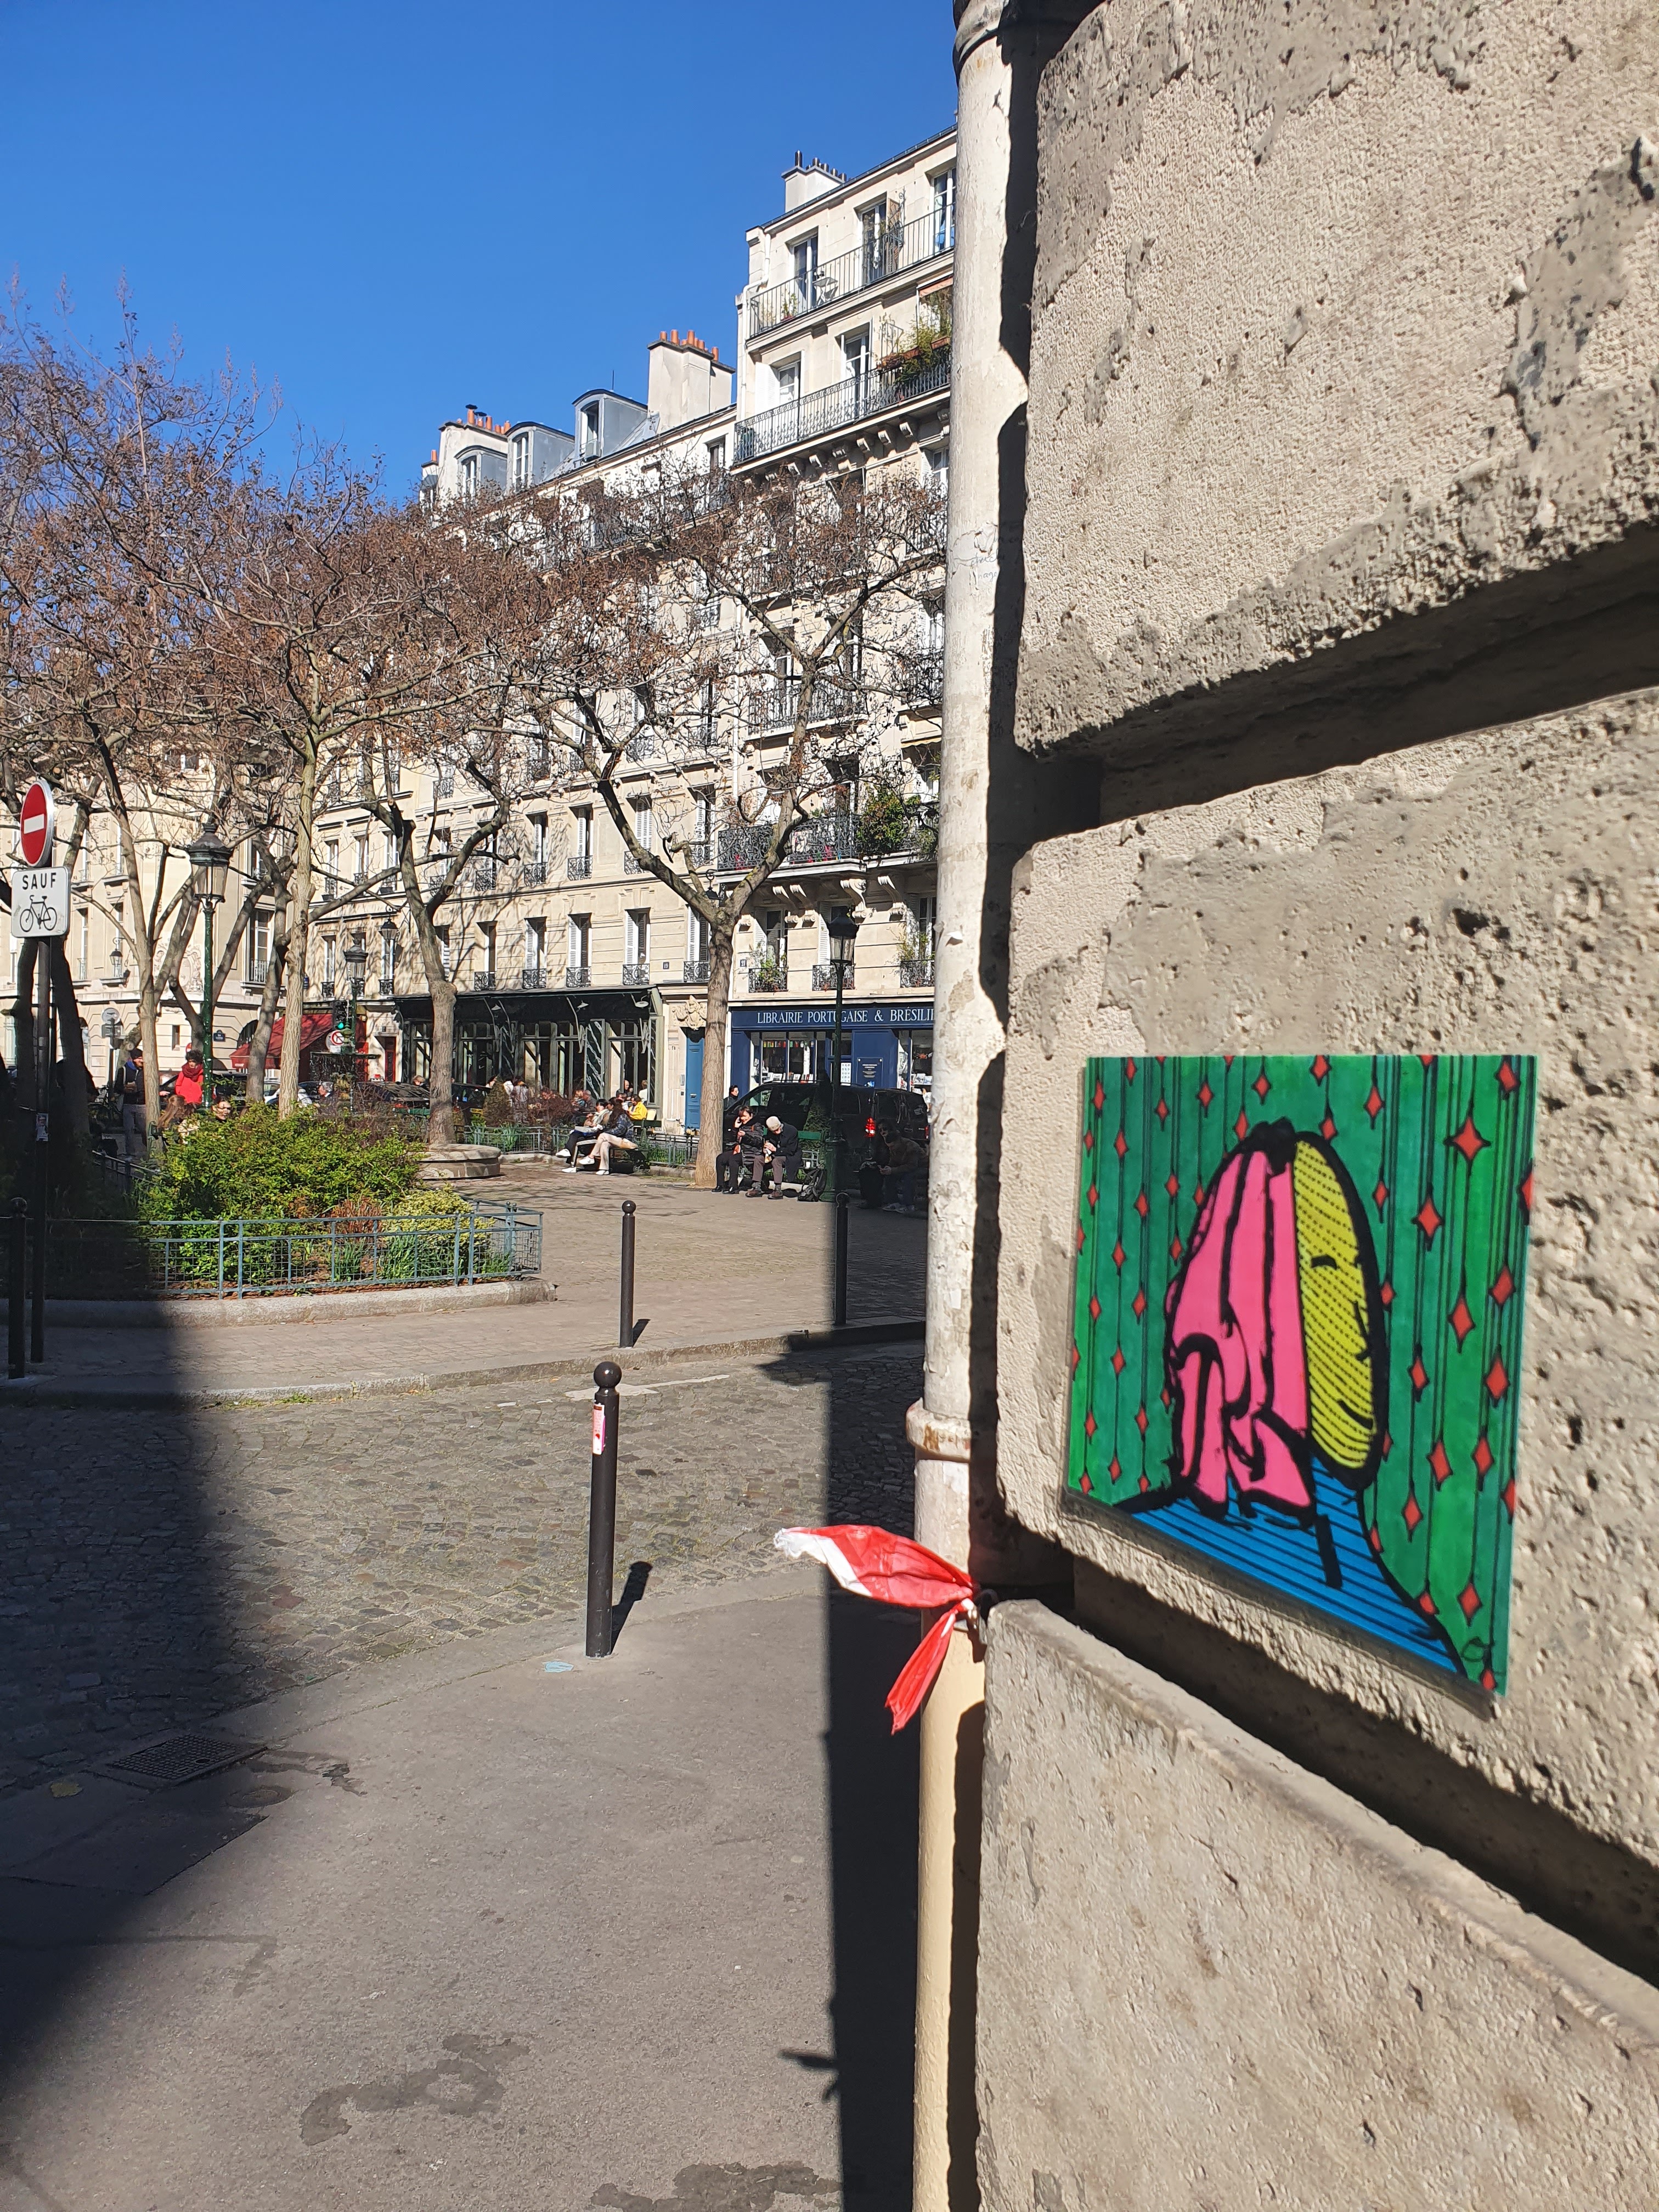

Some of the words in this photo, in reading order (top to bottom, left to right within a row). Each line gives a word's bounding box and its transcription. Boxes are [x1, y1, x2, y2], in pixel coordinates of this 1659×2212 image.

[22, 872, 57, 890] SAUF
[757, 1012, 803, 1024] LIBRAIRIE
[874, 1009, 884, 1022] &
